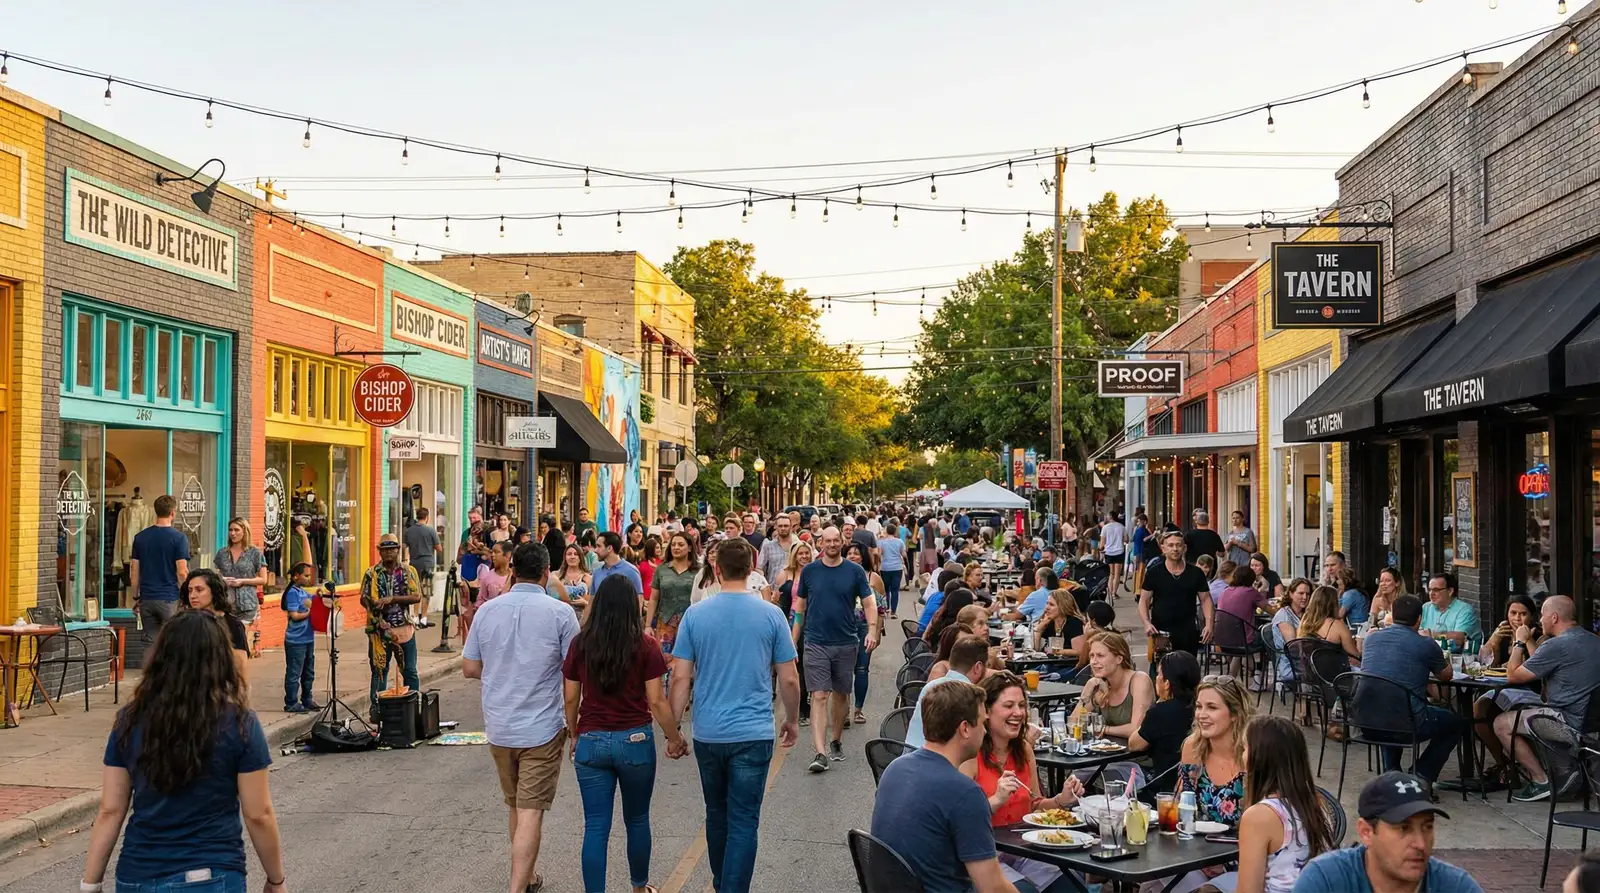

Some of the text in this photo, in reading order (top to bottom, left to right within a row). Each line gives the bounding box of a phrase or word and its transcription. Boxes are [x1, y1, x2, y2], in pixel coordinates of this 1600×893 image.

[78, 190, 228, 275] THE WILD DETECTIVE
[1316, 253, 1339, 268] THE
[1283, 271, 1372, 298] TAVERN
[396, 304, 465, 349] BISHOP CIDER
[480, 334, 510, 361] ARTIST'S
[1105, 367, 1177, 383] PROOF
[360, 380, 406, 396] BISHOP
[1423, 376, 1485, 412] THE TAVERN
[364, 397, 402, 412] CIDER
[1305, 411, 1343, 436] THE TAVERN
[56, 501, 91, 513] DETECTIVE
